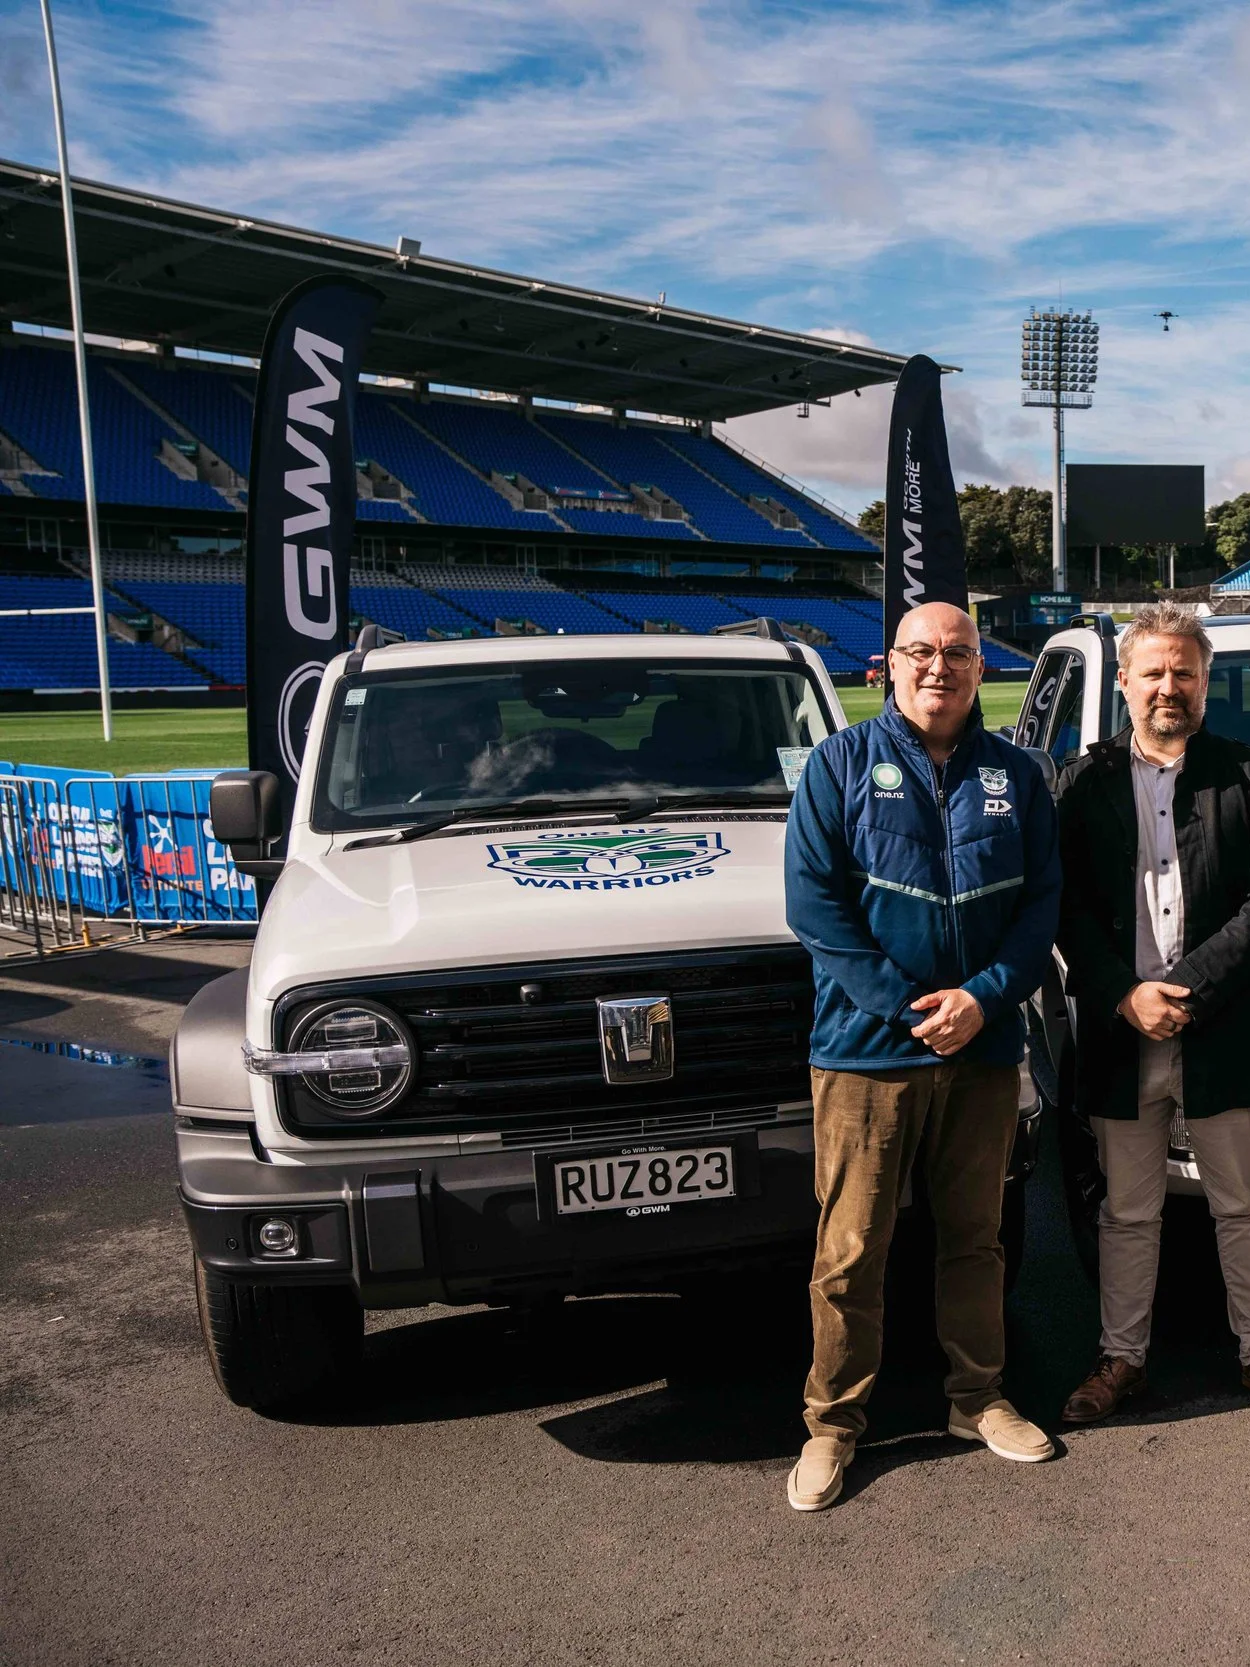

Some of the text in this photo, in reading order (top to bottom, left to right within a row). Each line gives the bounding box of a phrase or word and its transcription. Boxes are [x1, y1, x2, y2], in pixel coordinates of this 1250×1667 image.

[283, 327, 344, 641] GWM
[908, 461, 923, 514] MORE
[902, 517, 926, 609] WM
[874, 791, 905, 799] one.nz
[538, 827, 671, 840] One NZ
[512, 866, 716, 891] WARRIORS
[561, 1152, 729, 1206] RUZ823
[641, 1204, 671, 1215] GWM
